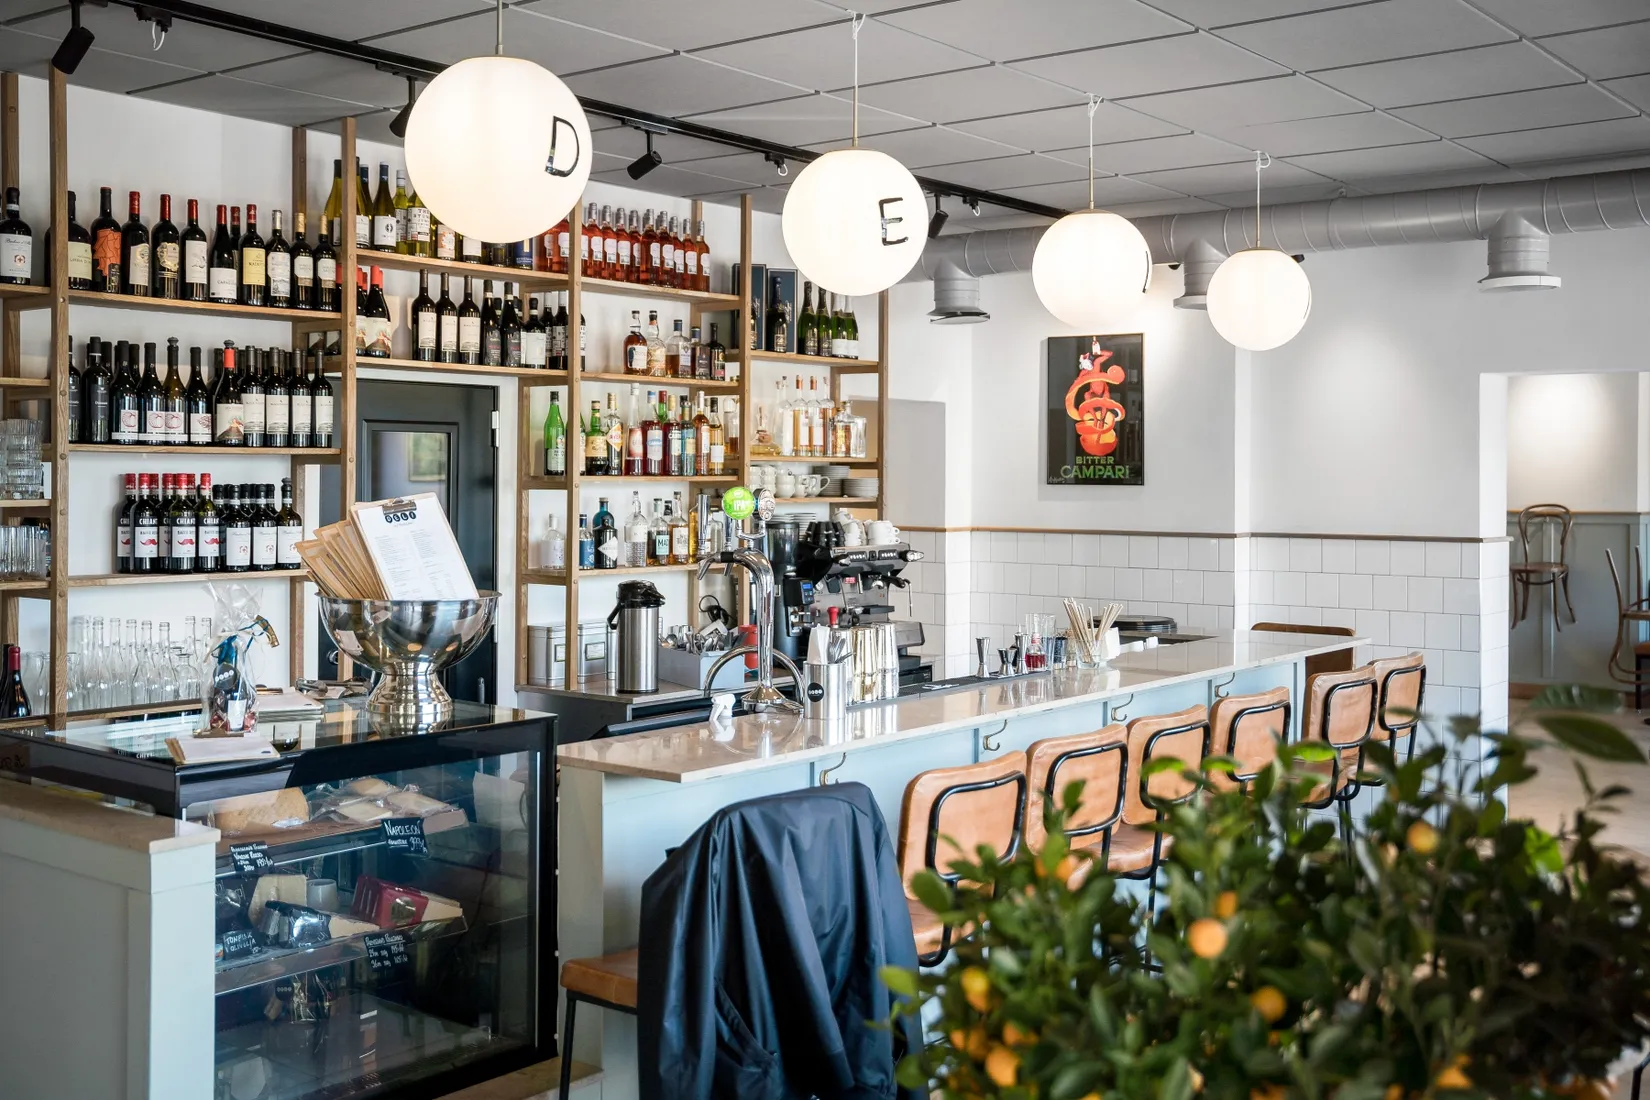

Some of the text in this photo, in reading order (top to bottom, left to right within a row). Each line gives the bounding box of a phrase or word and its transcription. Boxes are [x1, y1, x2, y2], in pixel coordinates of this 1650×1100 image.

[544, 115, 580, 178] D
[878, 196, 909, 247] E
[1075, 455, 1115, 465] BITTER
[1060, 465, 1130, 479] CAMPARI
[385, 510, 417, 523] DELI
[384, 820, 421, 836] NAPOLEON
